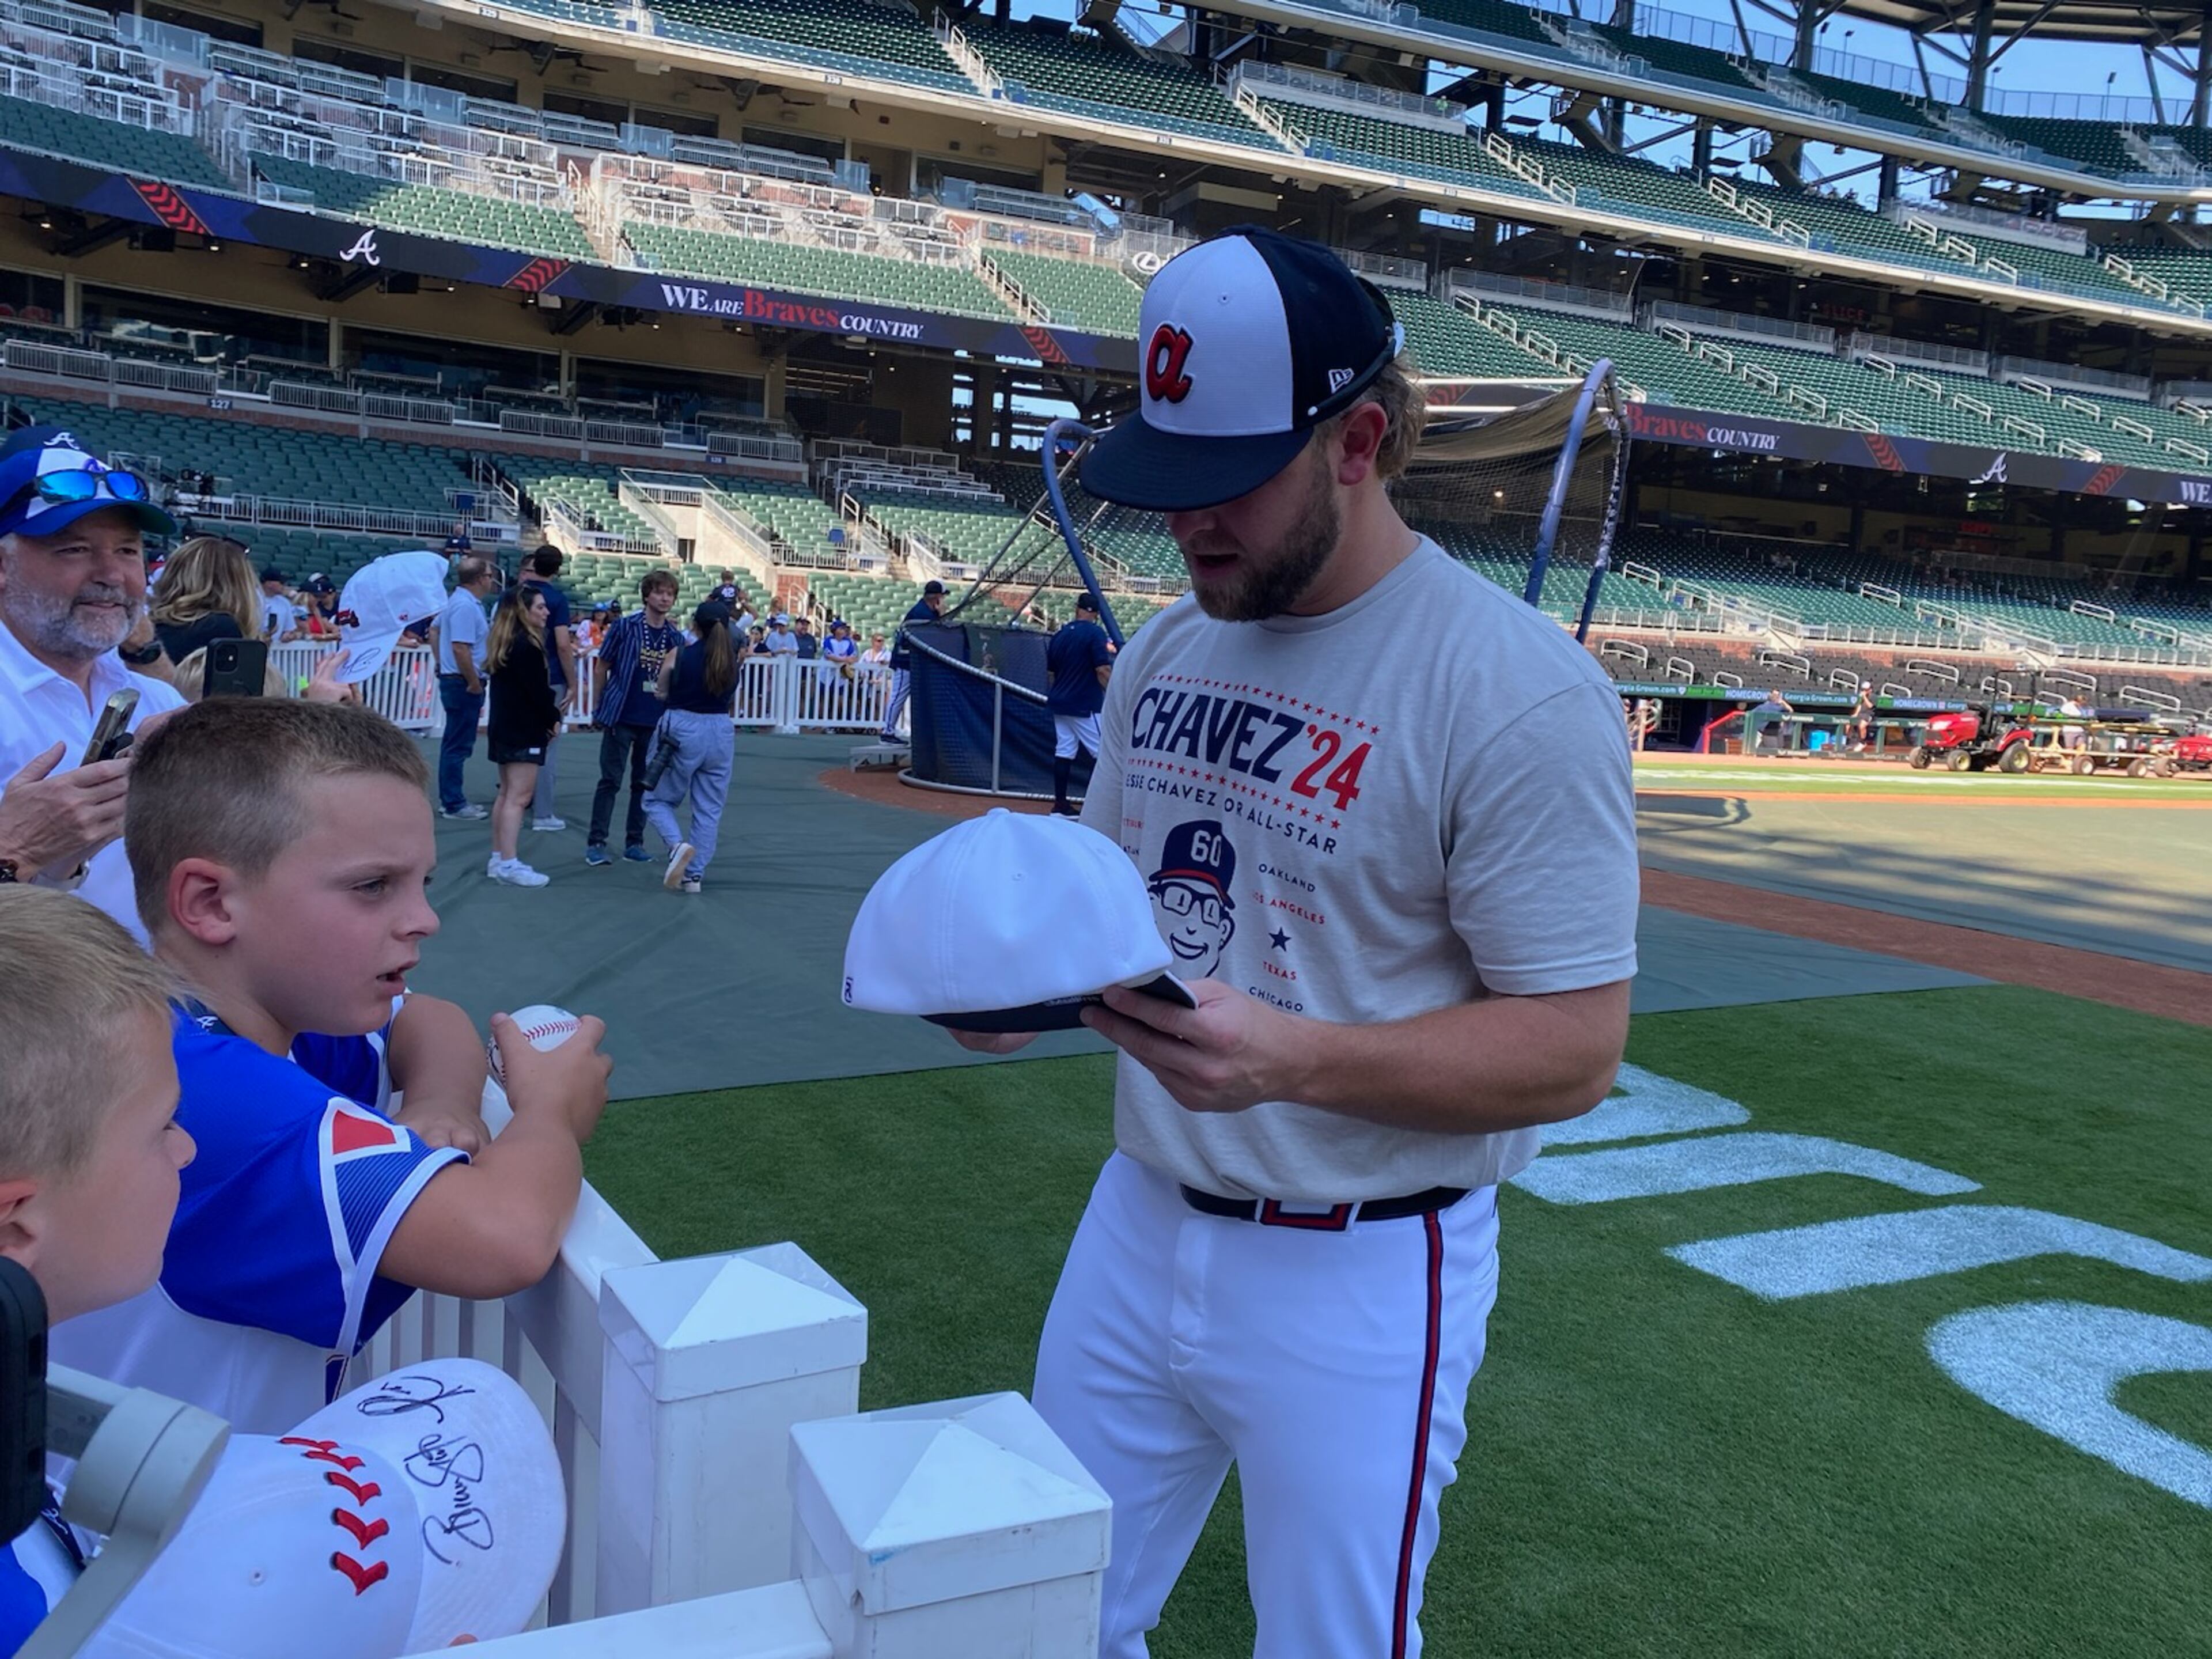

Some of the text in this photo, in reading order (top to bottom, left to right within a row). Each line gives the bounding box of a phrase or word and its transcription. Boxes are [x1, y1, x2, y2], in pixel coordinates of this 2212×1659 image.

[340, 229, 380, 266] A
[661, 283, 924, 339] WE ARE Braves COUNTRY
[211, 399, 230, 410] 127
[1626, 404, 1707, 442] Braves
[1707, 427, 1780, 450] COUNTRY
[1982, 452, 2008, 483] A
[2180, 481, 2211, 502] WE
[1893, 698, 1937, 709] HOMEGROWN
[1131, 687, 1306, 784] CHAVEZ
[1147, 777, 1217, 806] CHAVEZ
[1225, 797, 1243, 817] OR
[1247, 807, 1336, 854] ALL-STAR
[1190, 829, 1222, 868] 60
[1259, 863, 1316, 892] OAKLAND
[1269, 898, 1325, 925] ANGELES
[1263, 960, 1297, 980] TEXAS
[1249, 986, 1304, 1012] CHICAGO
